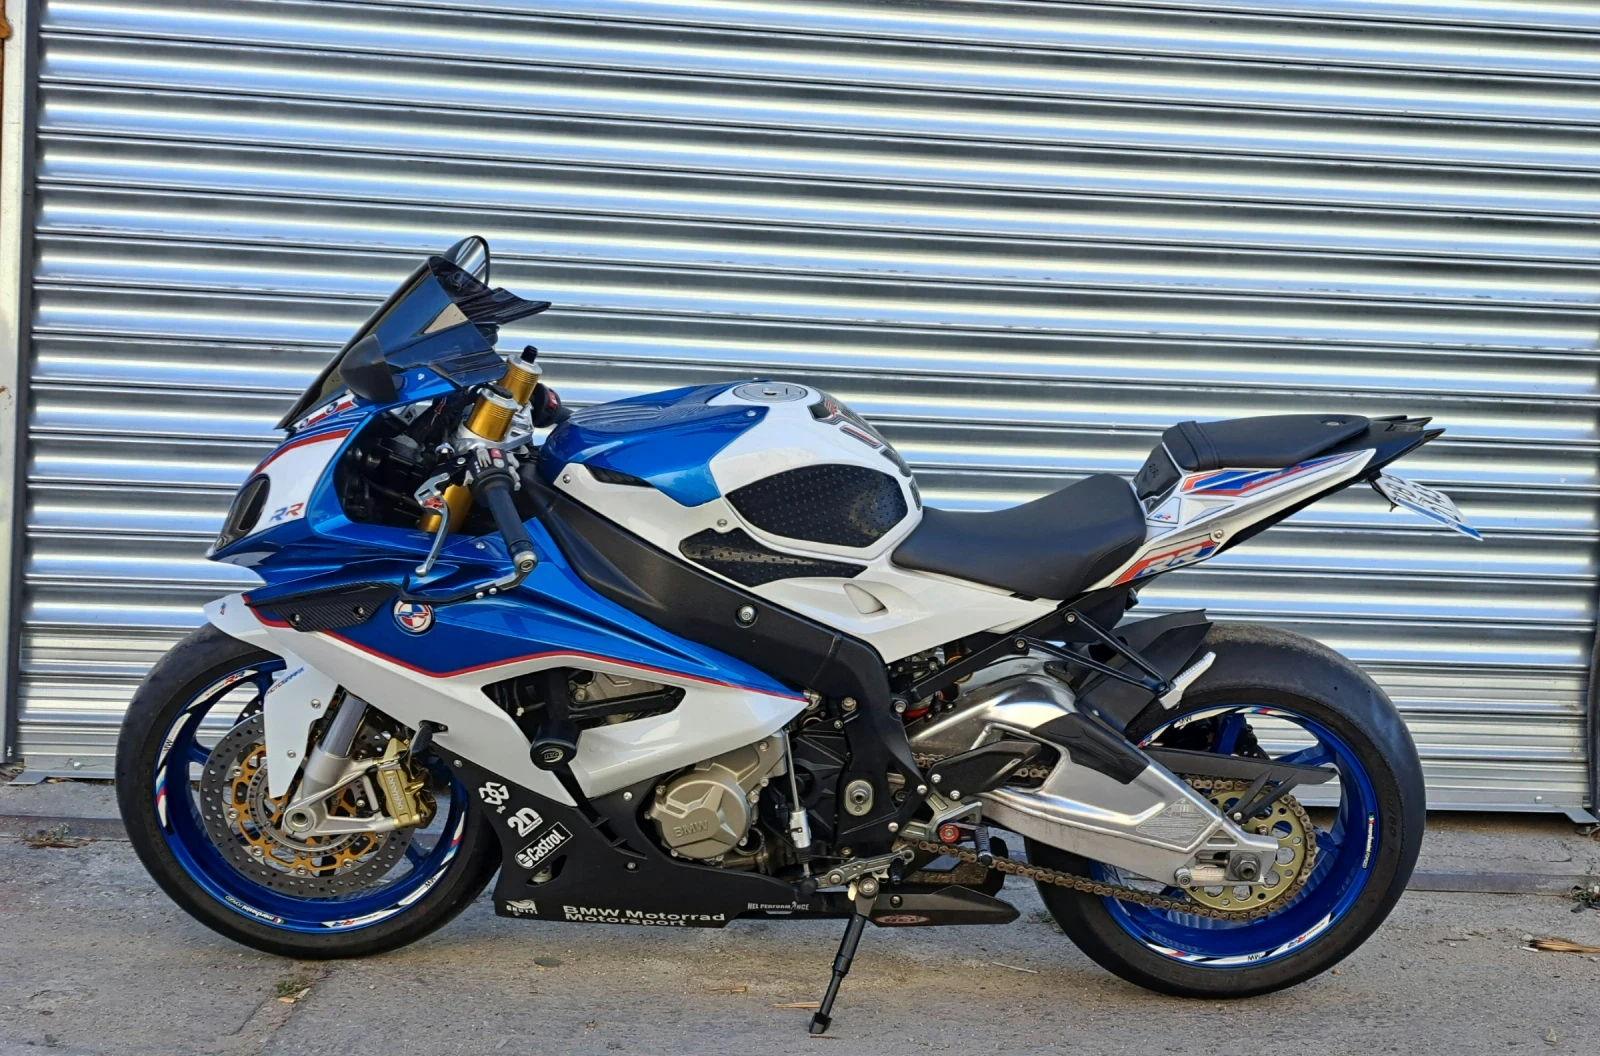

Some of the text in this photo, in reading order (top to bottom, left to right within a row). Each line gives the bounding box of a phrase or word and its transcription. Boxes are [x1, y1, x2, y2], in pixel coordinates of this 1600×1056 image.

[269, 502, 304, 521] RR
[387, 775, 404, 811] brembo
[673, 820, 708, 839] BMW
[526, 829, 566, 862] Castrol
[562, 905, 725, 921] BMW Motorrad
[565, 913, 686, 927] Motorsport
